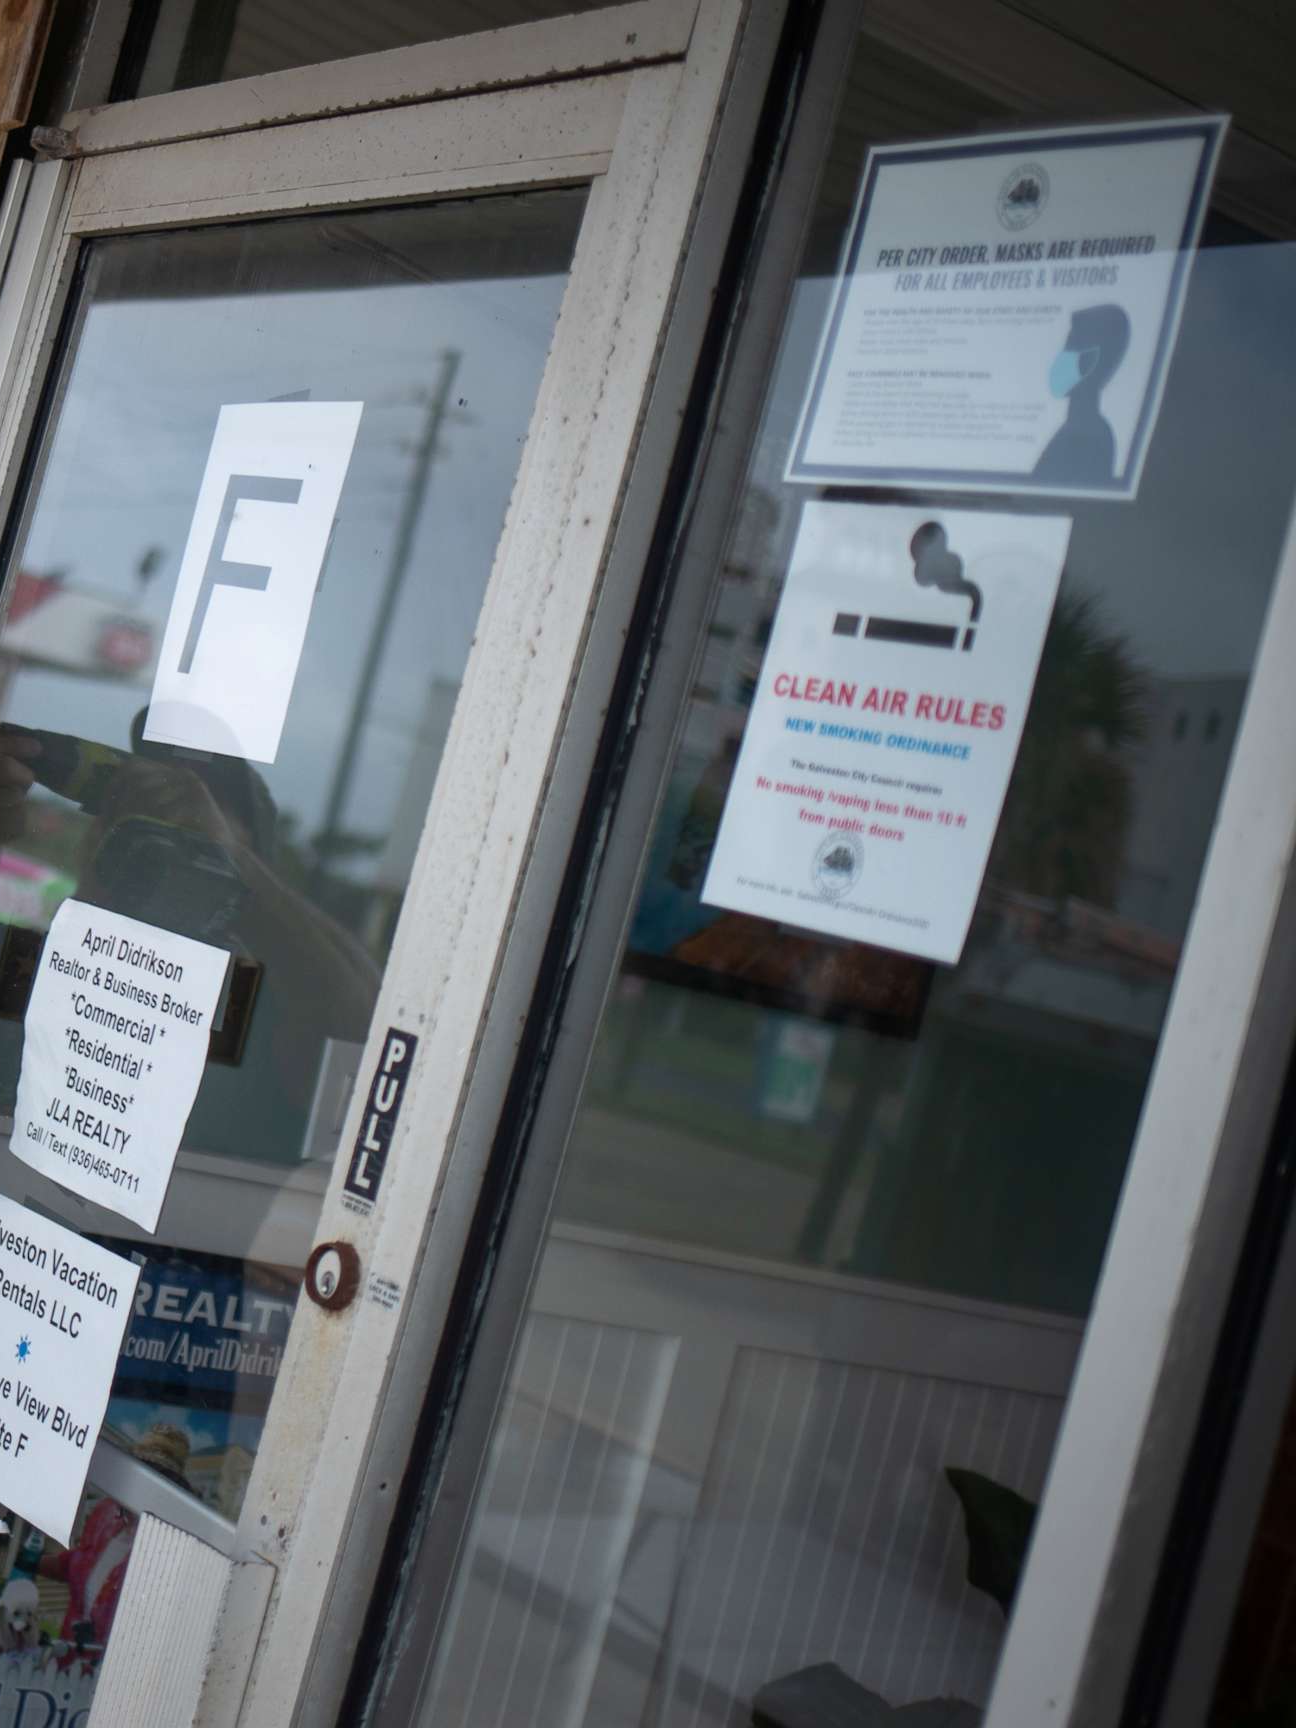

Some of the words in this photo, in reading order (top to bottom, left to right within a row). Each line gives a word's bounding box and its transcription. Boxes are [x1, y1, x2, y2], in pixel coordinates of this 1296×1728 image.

[877, 249, 903, 268] PER
[907, 247, 937, 267] CITY
[995, 241, 1044, 263] MASKS
[1047, 239, 1075, 260] ARE
[1080, 235, 1156, 258] REQUIRED
[895, 272, 922, 291] FOR
[924, 272, 948, 291] ALL
[952, 269, 1032, 291] EMPLOYEES
[1037, 268, 1045, 287] &
[1052, 265, 1119, 287] VISITORS
[177, 474, 304, 675] F
[773, 673, 857, 708] CLEAN
[862, 686, 909, 717] AIR
[915, 693, 1007, 731] RULES
[785, 716, 814, 734] NEW
[818, 719, 882, 745] SMOKING
[887, 733, 972, 761] ORDINANCE
[756, 776, 771, 789] No
[775, 782, 824, 803] smoking
[874, 800, 900, 815] less
[904, 805, 933, 822] than
[791, 759, 806, 770] The
[808, 762, 850, 778] Galveston
[851, 769, 869, 784] City
[870, 774, 904, 788] Council
[799, 808, 825, 825] from
[828, 816, 864, 833] public
[869, 824, 904, 842] doors
[81, 928, 115, 957] April
[117, 939, 184, 983] Didrikson
[49, 951, 90, 983] Realtor
[92, 968, 102, 985] &
[104, 972, 158, 1010] Business
[160, 994, 203, 1027] Broker
[46, 1097, 69, 1128] JLA
[73, 1109, 131, 1155] REALTY
[353, 1038, 407, 1189] PULL
[26, 1121, 43, 1143] Call
[49, 1133, 69, 1158] Text
[68, 1145, 140, 1193] (936)465-0711
[51, 1248, 119, 1309] Vacation
[49, 1299, 82, 1339] LLC
[16, 1381, 51, 1424] View
[51, 1406, 90, 1449] Blvd
[15, 1432, 28, 1459] F
